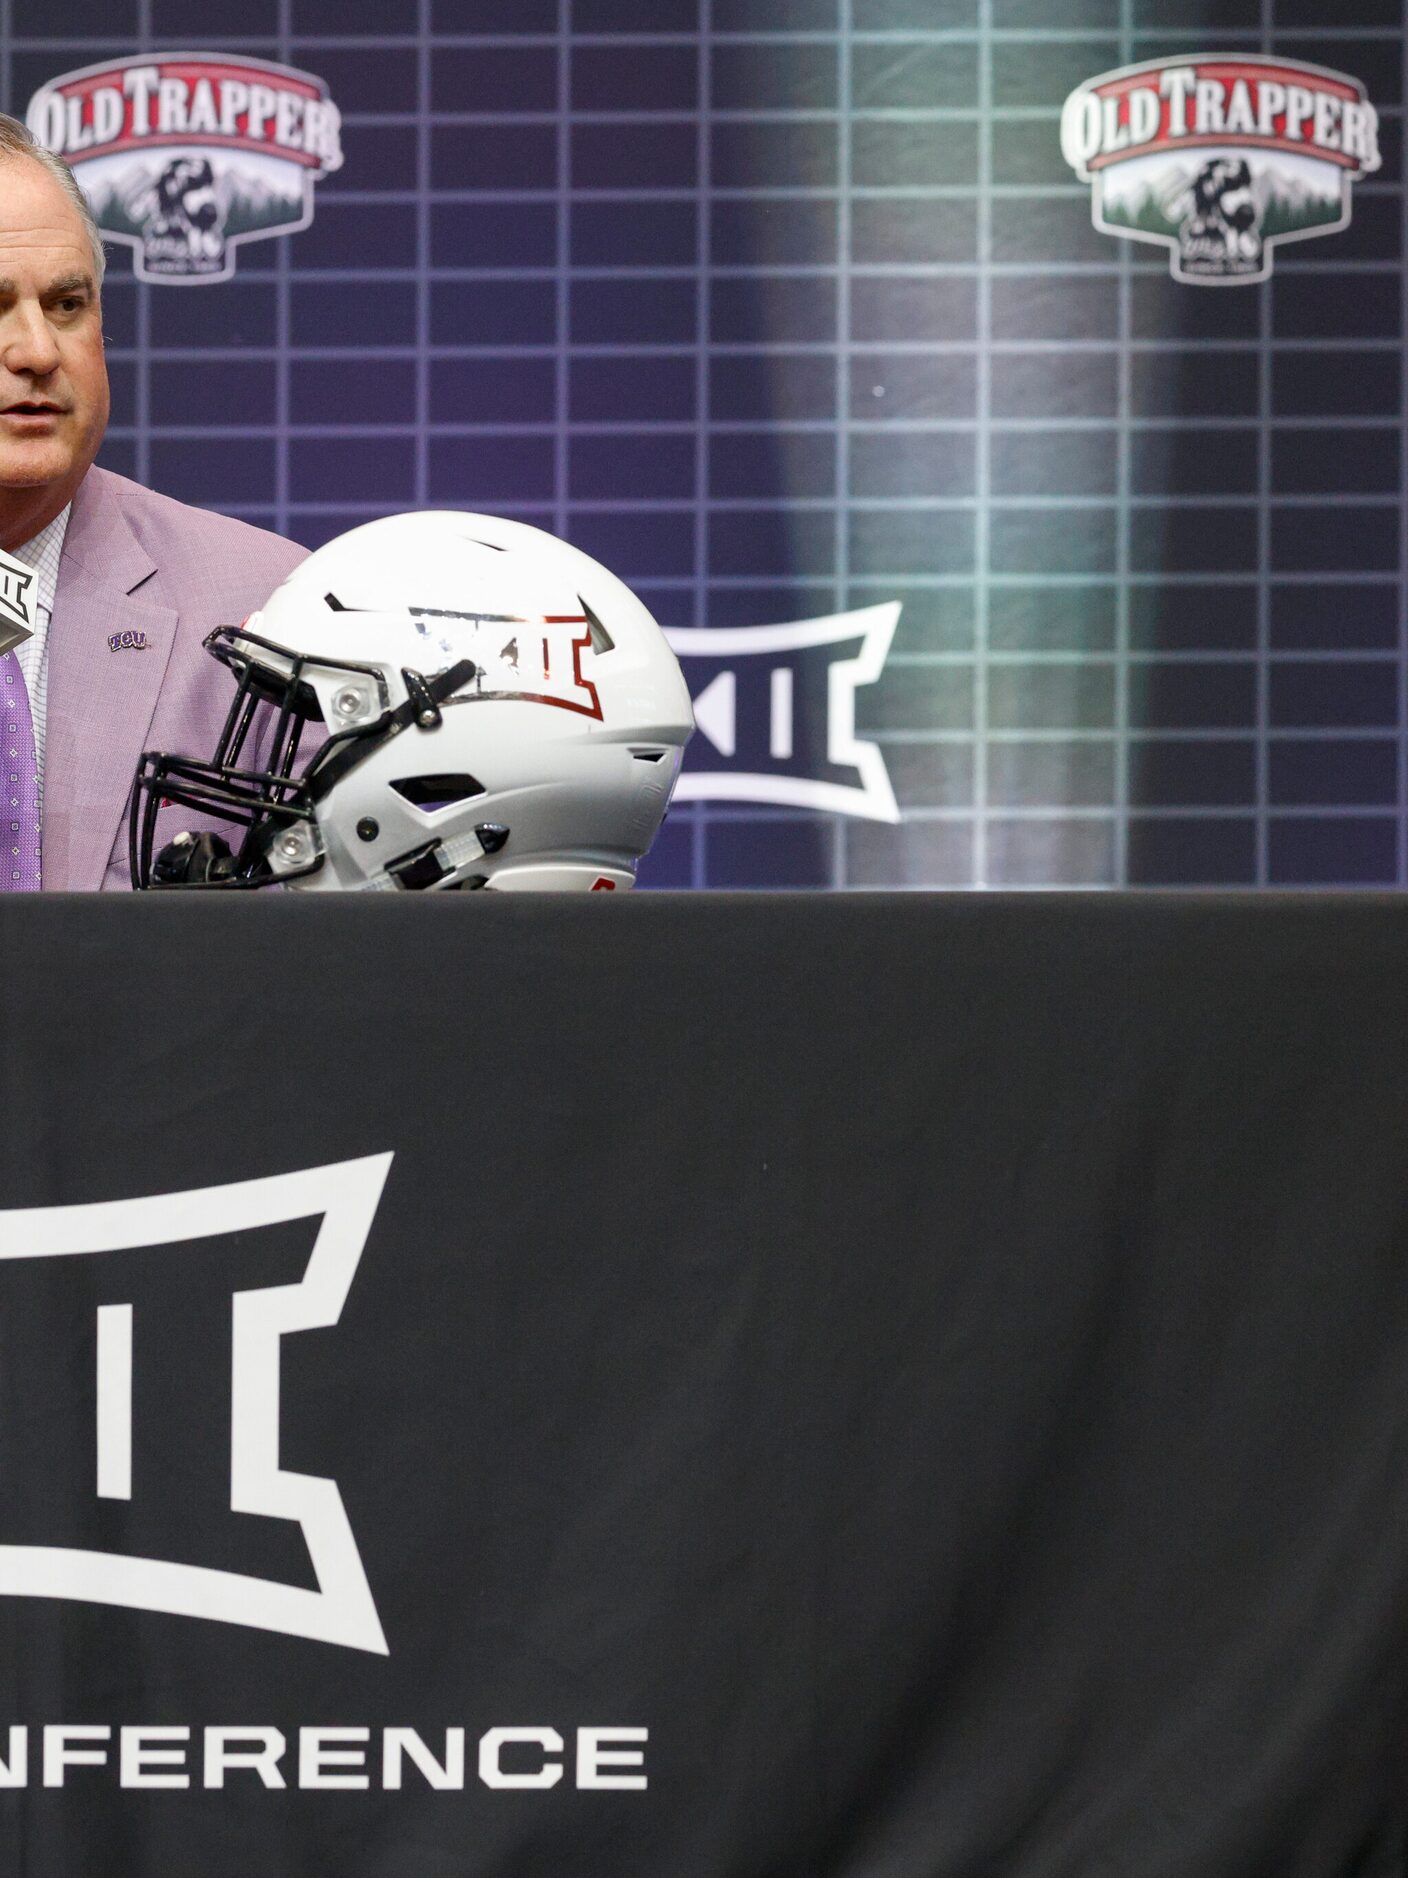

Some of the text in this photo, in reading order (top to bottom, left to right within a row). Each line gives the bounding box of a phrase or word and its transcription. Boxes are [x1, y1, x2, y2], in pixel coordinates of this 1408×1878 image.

[26, 66, 343, 171] OLD TRAPPER
[1061, 66, 1381, 172] OLD TRAPPER
[108, 630, 146, 652] TCU
